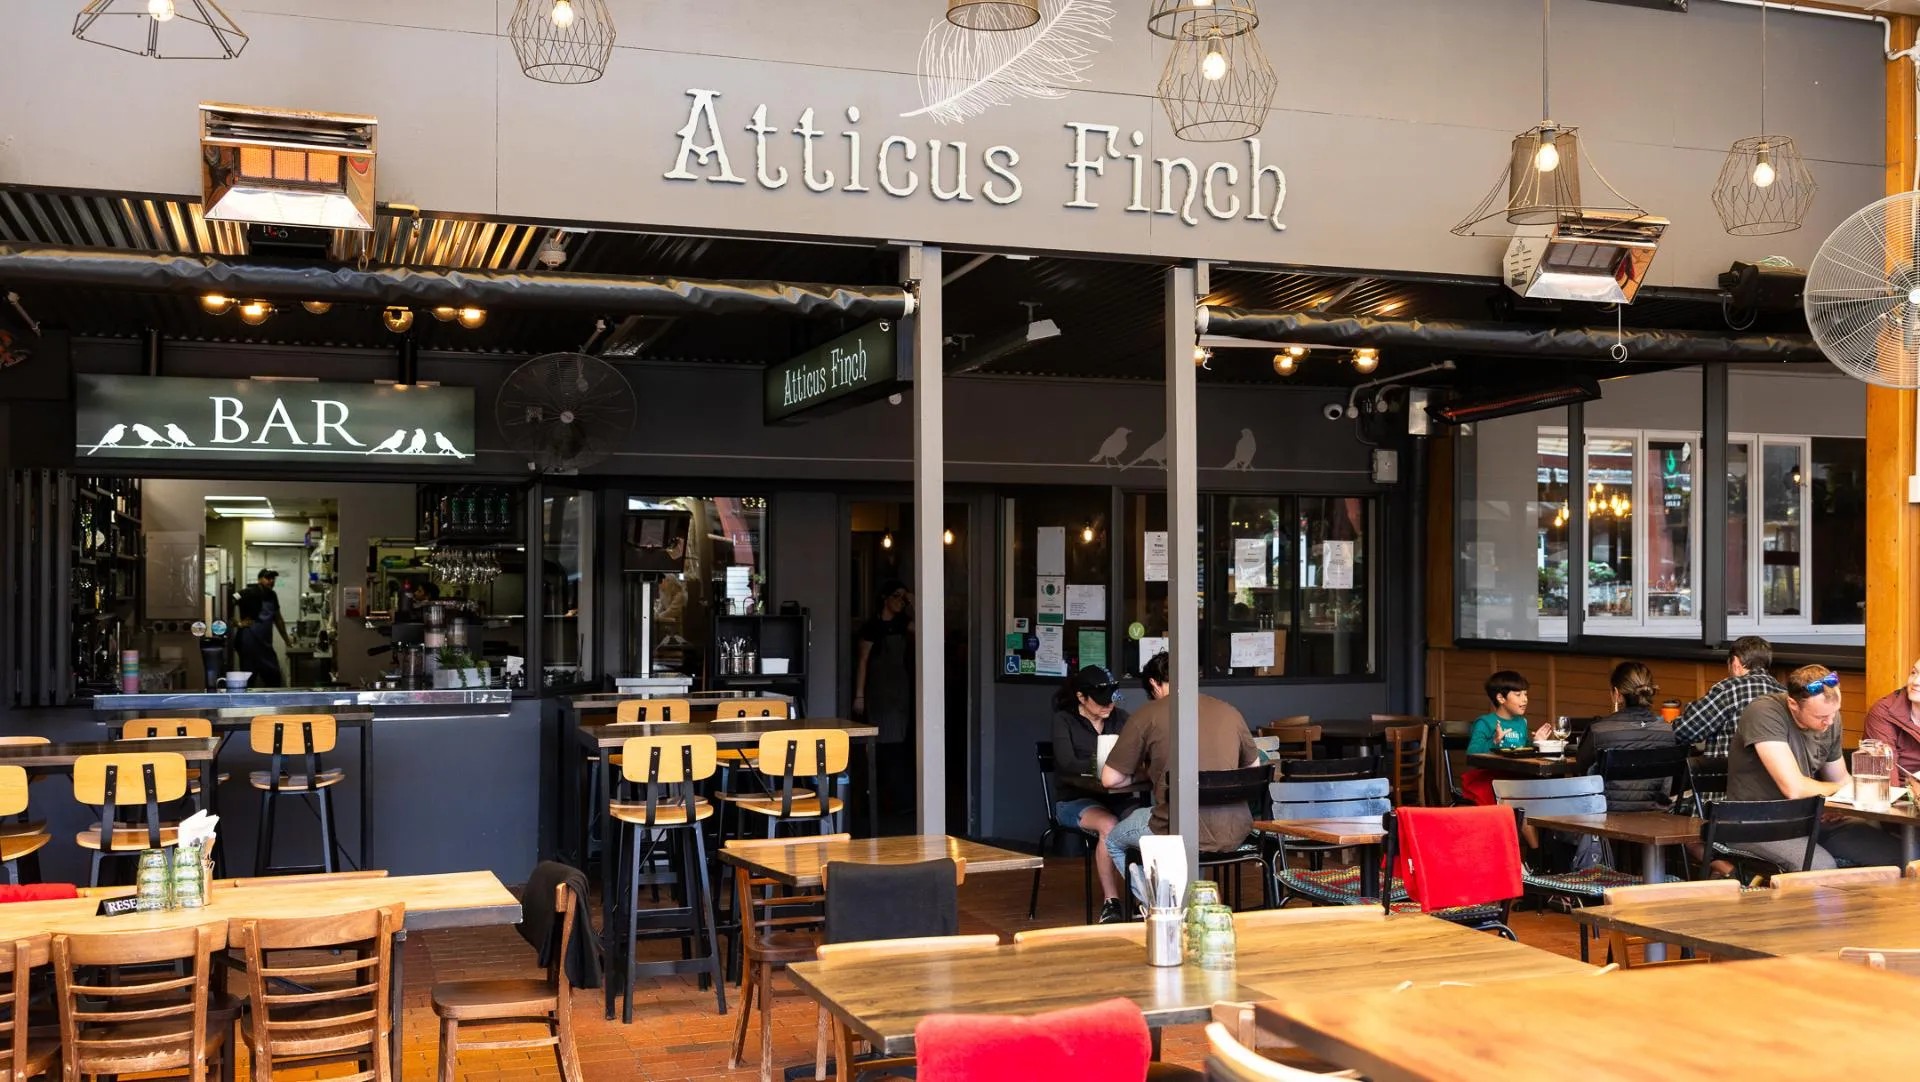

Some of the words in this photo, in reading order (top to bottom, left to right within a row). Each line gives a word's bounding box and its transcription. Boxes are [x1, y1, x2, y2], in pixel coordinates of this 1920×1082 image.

[663, 88, 1023, 206] Atticus
[1063, 120, 1289, 232] Finch
[783, 363, 827, 407] Atticus
[830, 338, 867, 388] Finch
[209, 395, 367, 447] BAR
